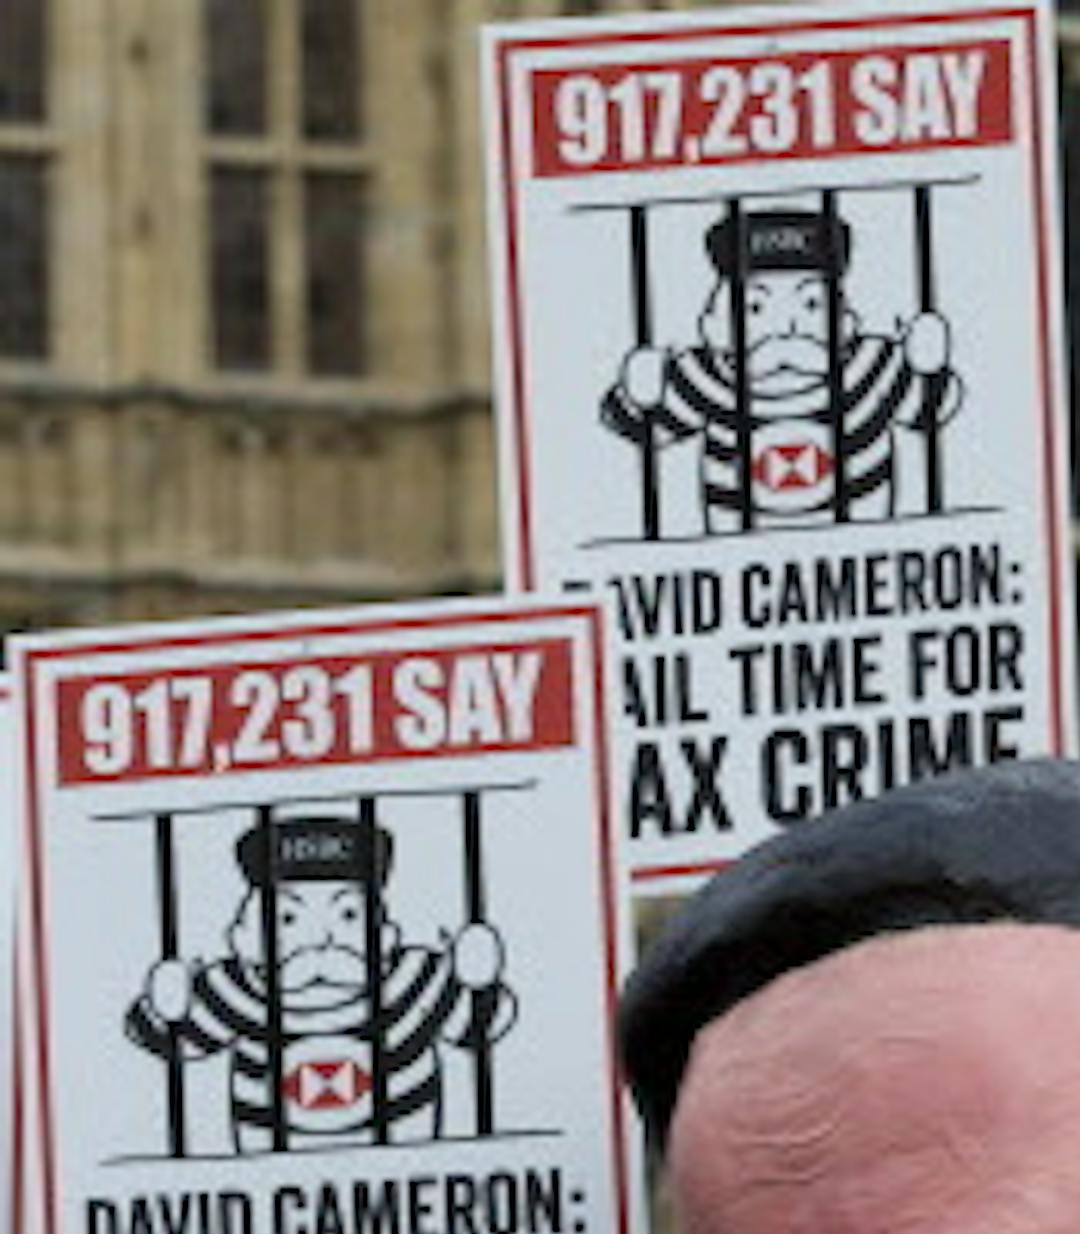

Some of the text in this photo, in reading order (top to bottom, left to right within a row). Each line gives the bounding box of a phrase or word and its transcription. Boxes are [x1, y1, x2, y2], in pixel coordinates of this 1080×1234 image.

[554, 51, 987, 164] 917,231 SAY
[740, 544, 1023, 629] CAMERON:
[81, 651, 542, 774] 917,231 SAY
[624, 623, 1023, 728] AIL TIME FOR
[629, 735, 733, 838] AX
